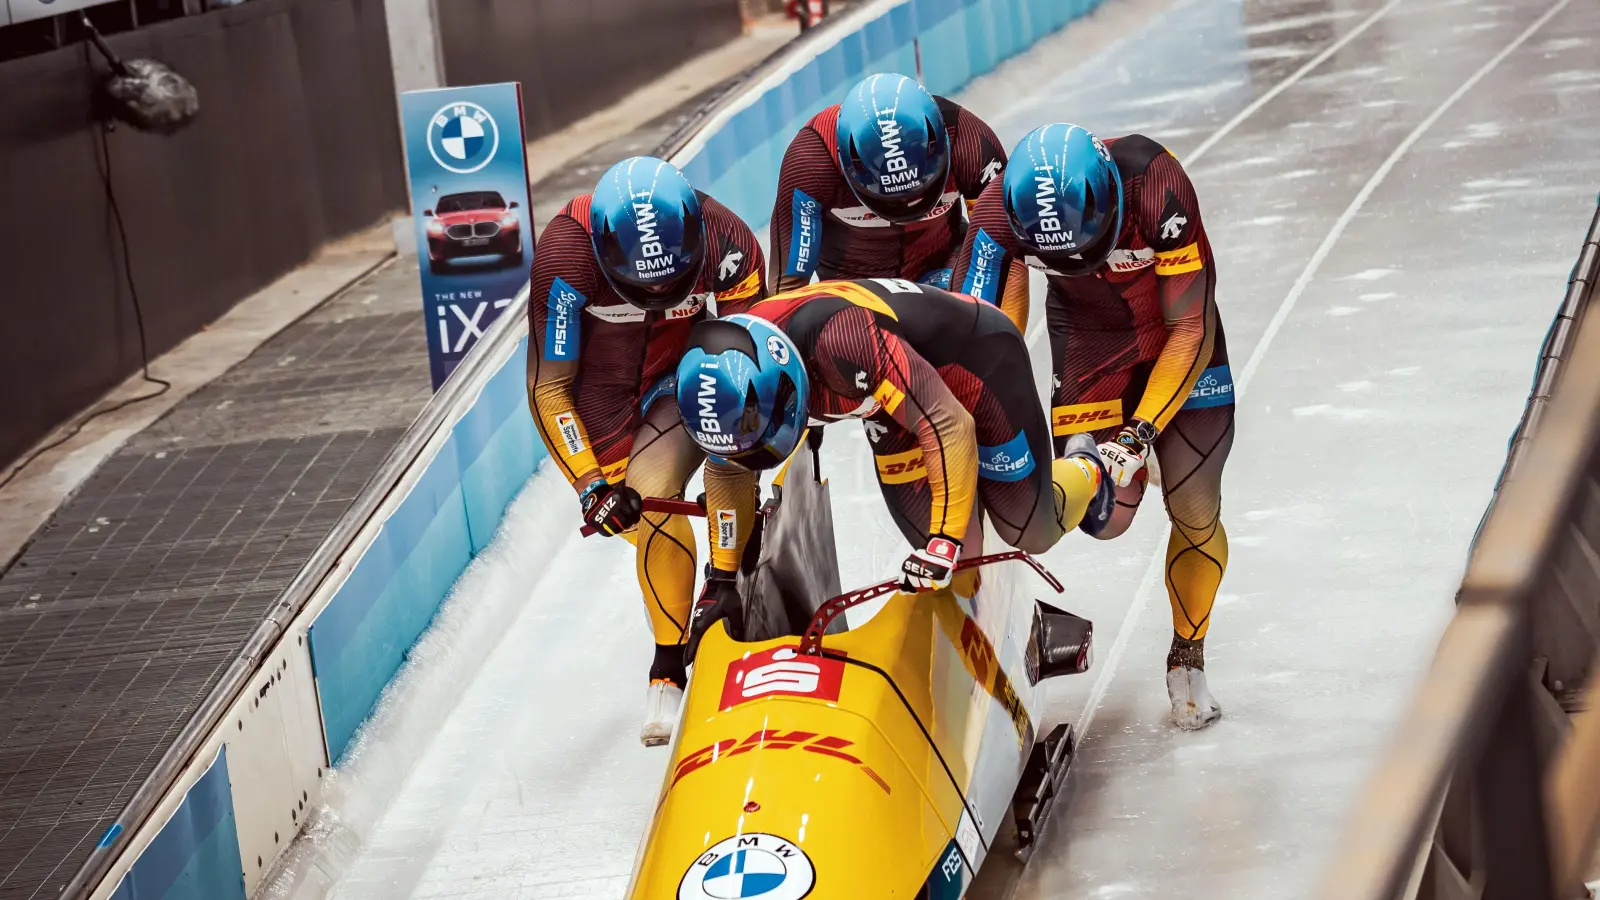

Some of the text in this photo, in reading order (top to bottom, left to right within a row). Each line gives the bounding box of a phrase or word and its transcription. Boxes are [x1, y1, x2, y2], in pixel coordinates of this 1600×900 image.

[435, 105, 487, 128] BMW
[877, 119, 908, 173] BMW
[880, 168, 919, 186] BMW
[884, 179, 920, 193] helmets
[1034, 176, 1062, 232] BMW
[632, 202, 664, 259] BMW
[1034, 230, 1073, 244] BMW
[1038, 241, 1076, 251] helmets
[635, 253, 674, 271] BMW
[638, 267, 675, 279] helmets
[435, 290, 482, 301] THE NEW
[437, 298, 512, 354] iX
[697, 373, 722, 433] BMW
[1057, 408, 1114, 426] DHL
[696, 431, 734, 444] BMW
[670, 729, 864, 790] DHL
[698, 836, 797, 868] BMW
[941, 847, 962, 882] FES
